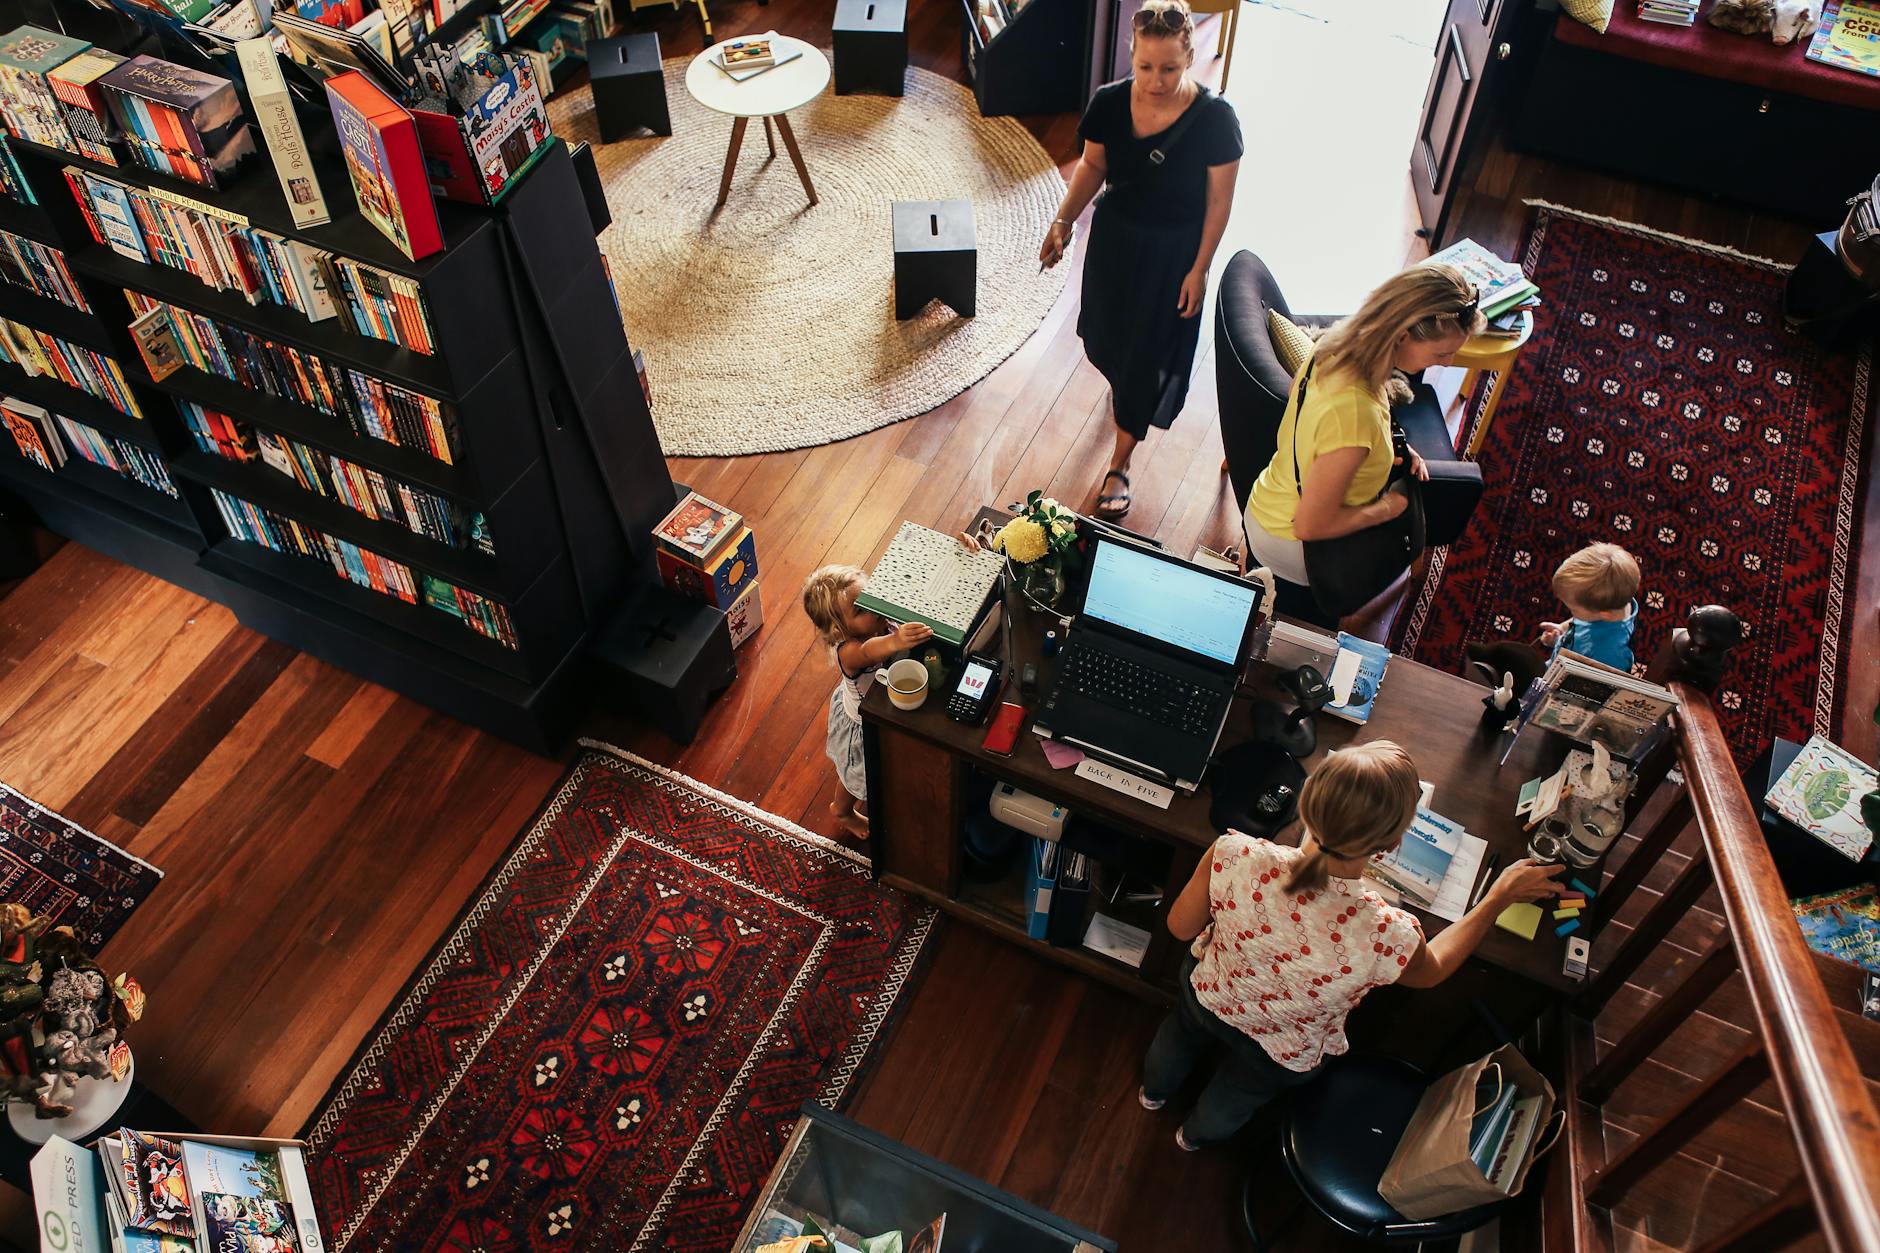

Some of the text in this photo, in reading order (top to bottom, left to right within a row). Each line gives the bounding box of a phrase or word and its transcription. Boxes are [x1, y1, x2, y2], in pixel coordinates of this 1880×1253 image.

[16, 41, 57, 60] GATES
[1841, 28, 1867, 39] from
[128, 67, 162, 83] HARRY
[160, 76, 197, 93] POTTER
[275, 106, 304, 170] Dolls House
[341, 118, 375, 159] CASTL
[475, 118, 508, 155] Maisy's
[510, 94, 536, 119] Castle
[150, 187, 247, 225] MIDDLE READER FICTION
[1087, 765, 1160, 799] BACK IN FIVE
[65, 1155, 78, 1209] PRESS
